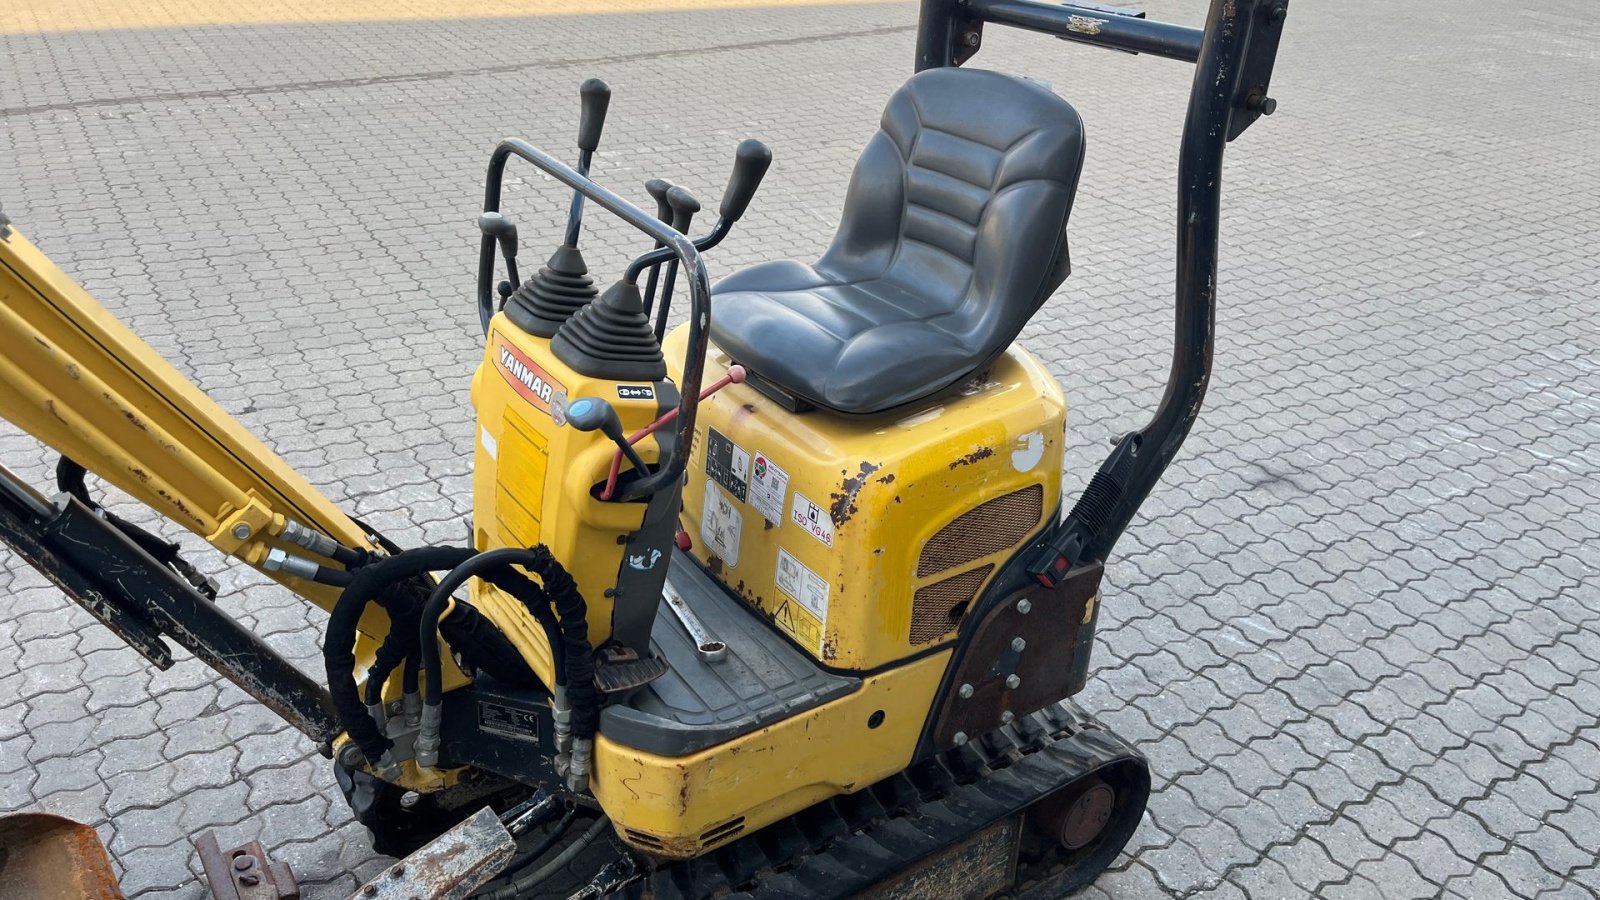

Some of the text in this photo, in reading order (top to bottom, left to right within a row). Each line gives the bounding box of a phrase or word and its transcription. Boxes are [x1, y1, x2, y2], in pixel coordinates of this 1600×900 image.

[500, 344, 552, 403] YANMAR
[794, 509, 808, 526] ISO
[811, 522, 832, 543] VG46
